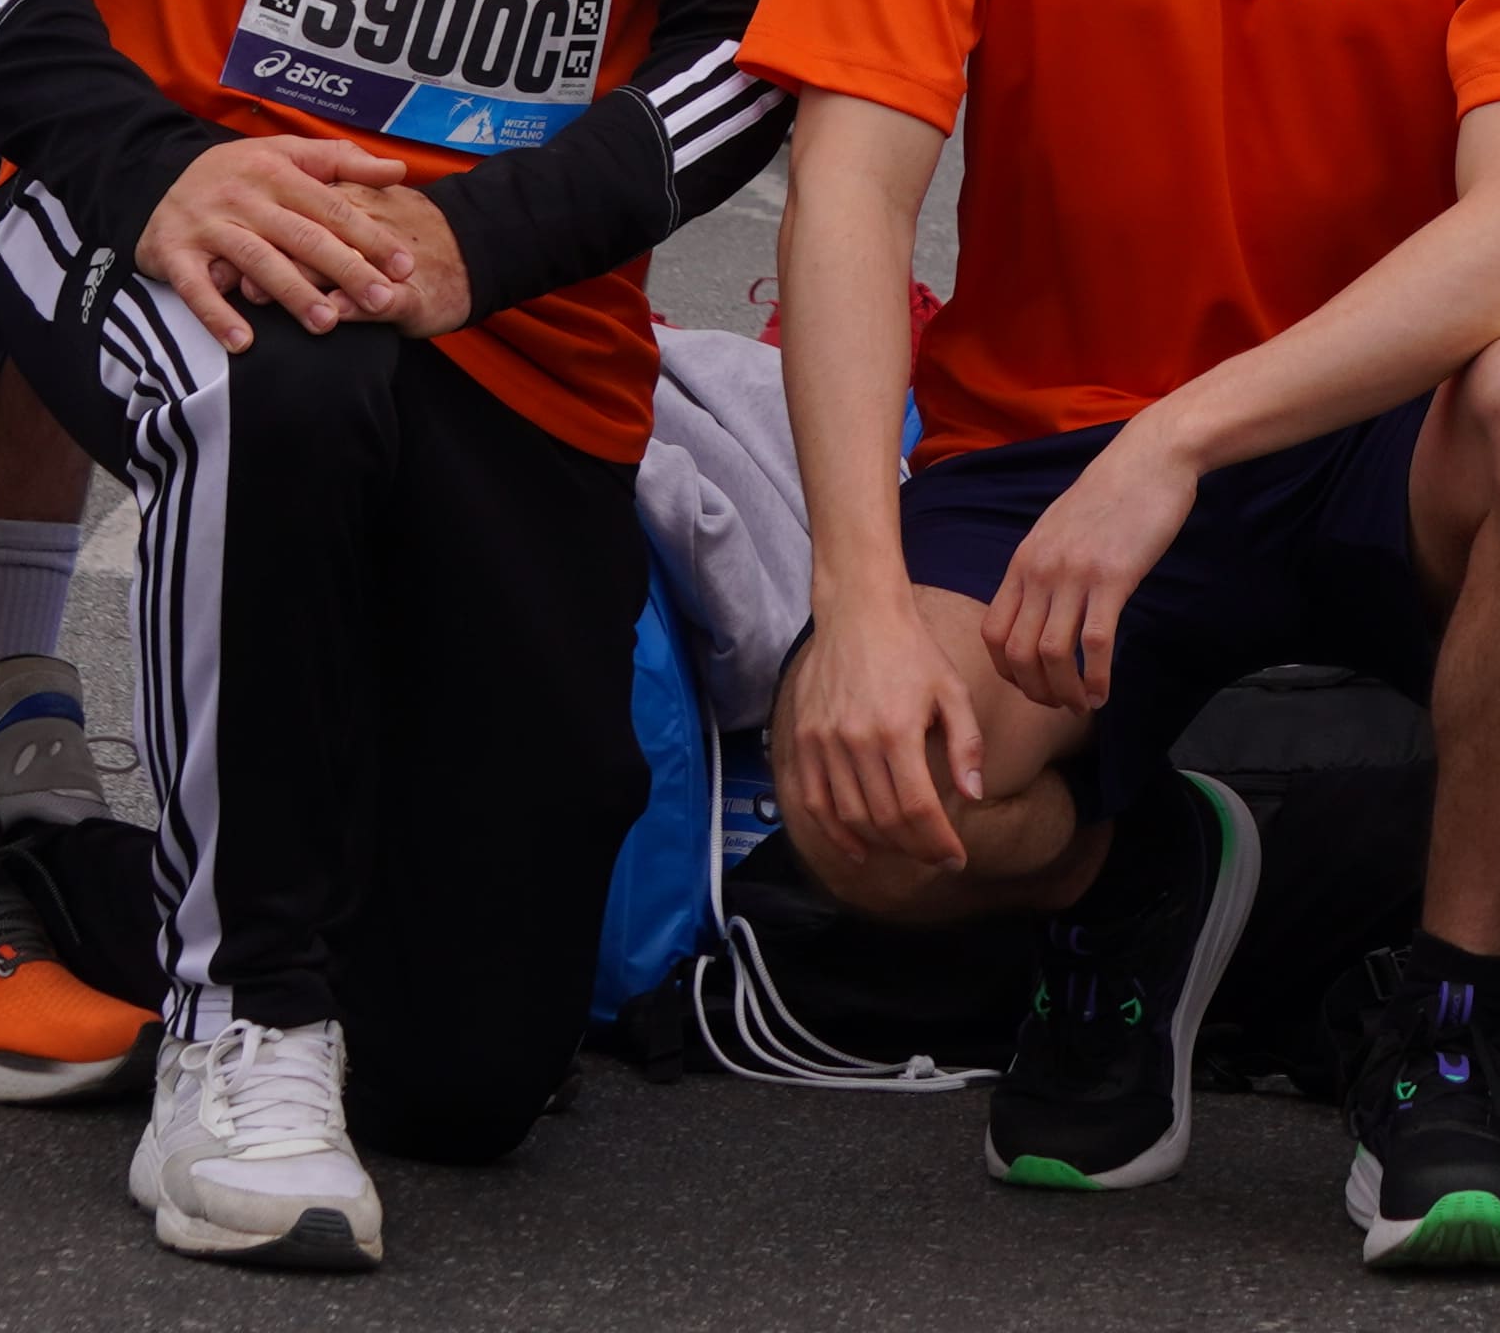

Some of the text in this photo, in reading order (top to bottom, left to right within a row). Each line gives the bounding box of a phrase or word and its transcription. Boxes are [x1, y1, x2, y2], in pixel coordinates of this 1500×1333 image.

[285, 62, 353, 98] asics
[275, 86, 297, 98] sound
[316, 98, 338, 110] sound
[339, 102, 358, 117] body
[500, 128, 544, 140] MILANO
